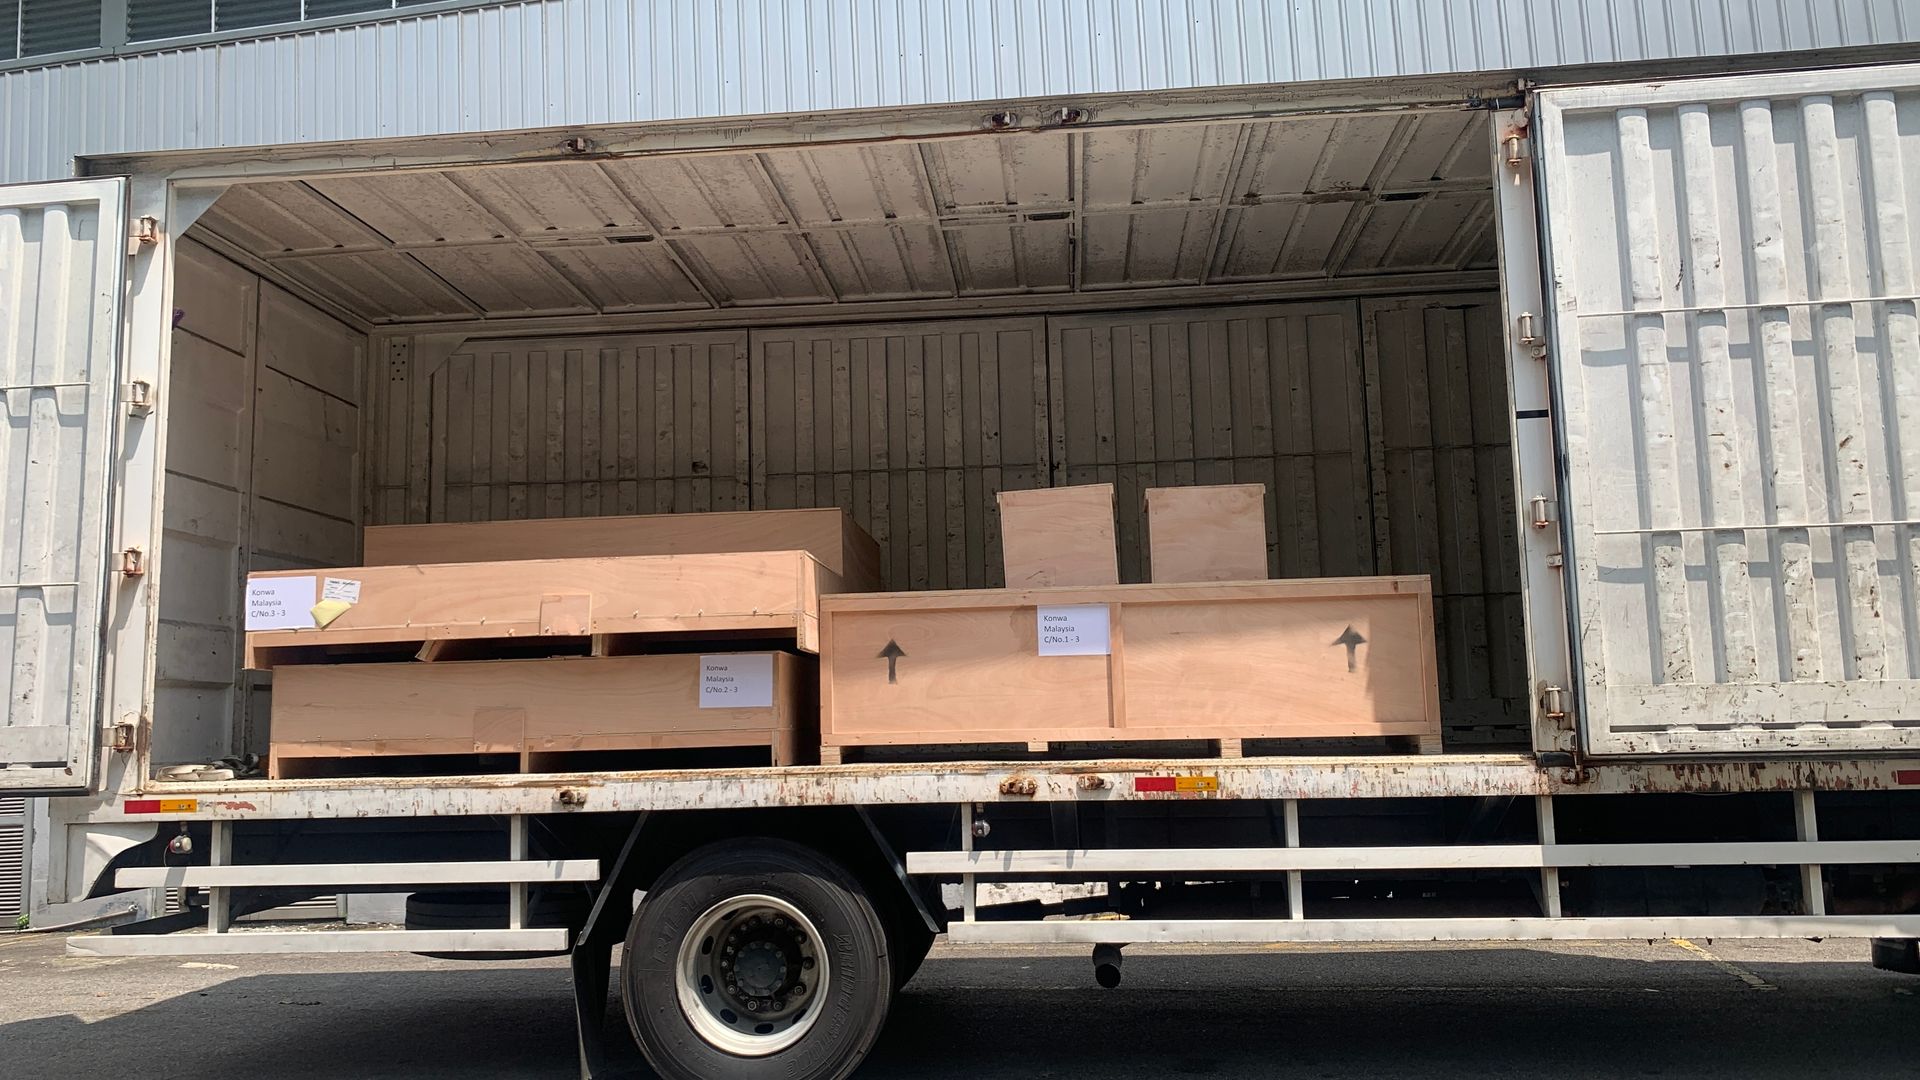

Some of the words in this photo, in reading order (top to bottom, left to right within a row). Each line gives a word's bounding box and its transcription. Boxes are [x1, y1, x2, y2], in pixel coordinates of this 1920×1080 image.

[251, 610, 275, 618] C/No.3
[1044, 636, 1069, 644] C/No.1
[1075, 635, 1080, 643] 3
